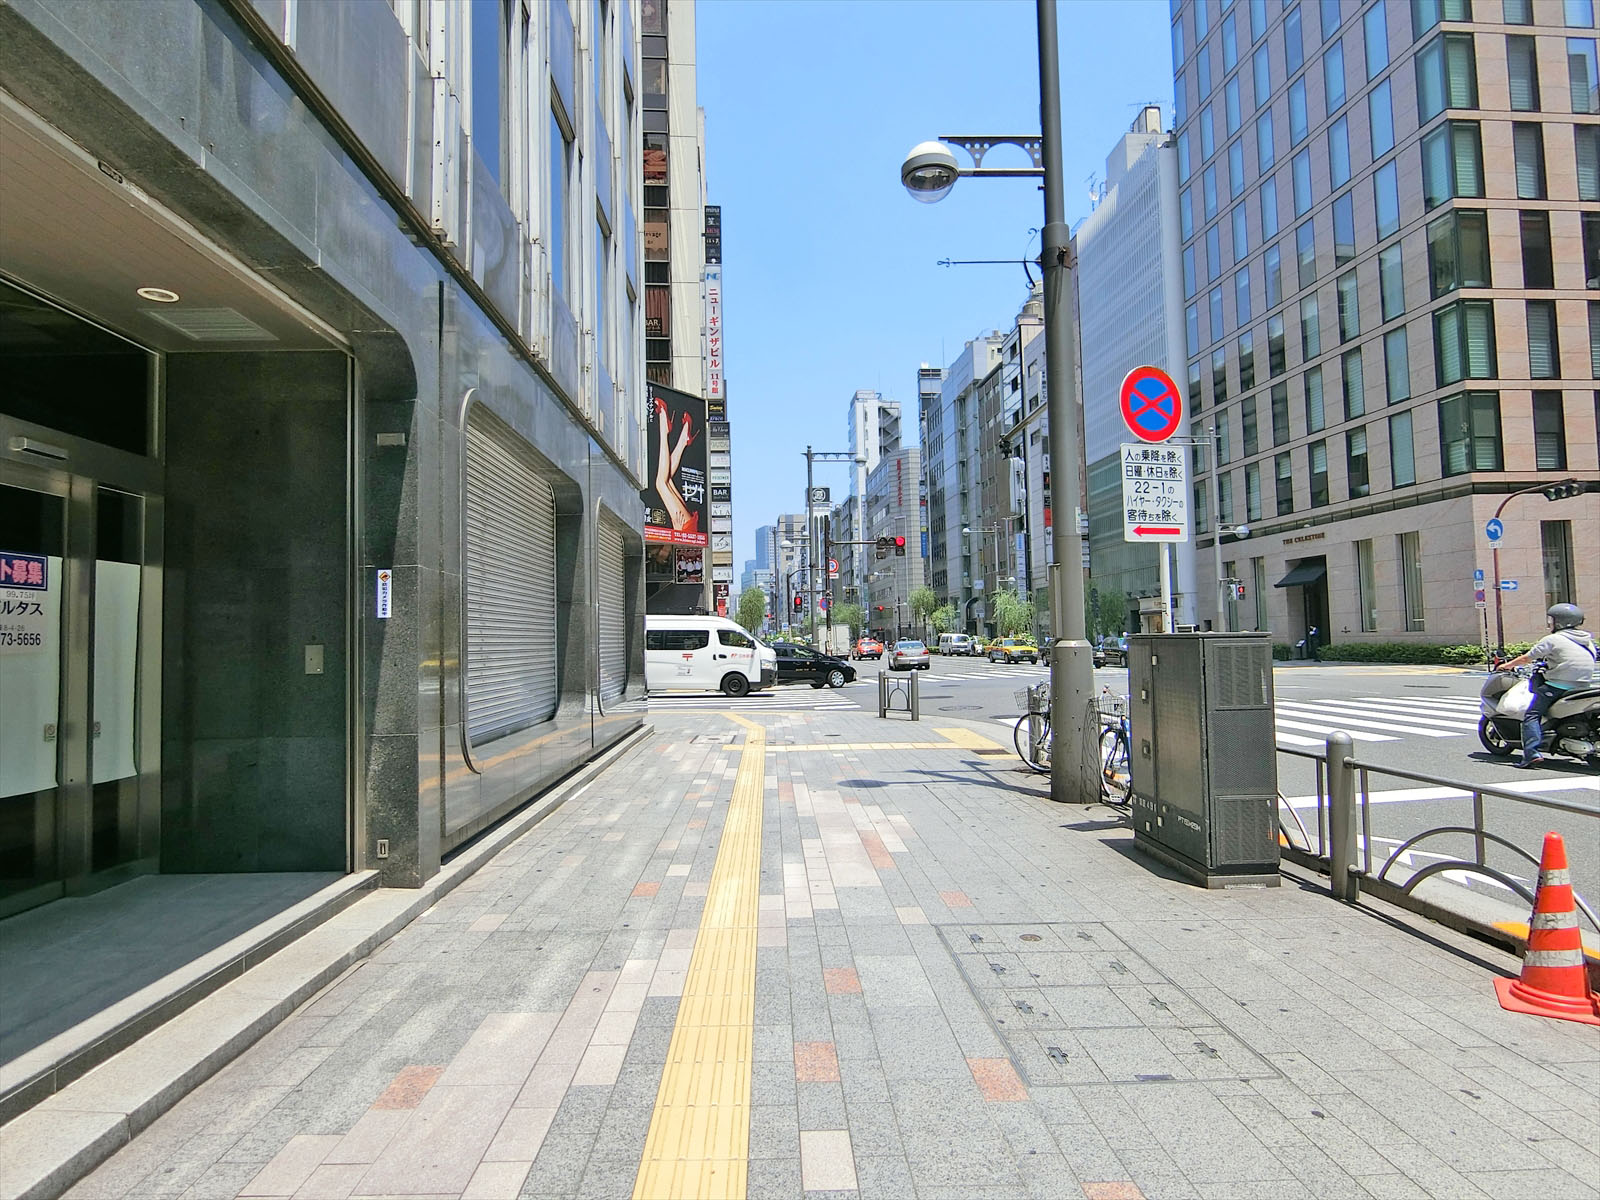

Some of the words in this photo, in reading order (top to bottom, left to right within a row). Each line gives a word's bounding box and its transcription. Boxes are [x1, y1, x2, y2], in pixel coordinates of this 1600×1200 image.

[708, 288, 720, 369] ニューギンザビル
[1125, 449, 1182, 463] 人の乗降を除く
[1126, 465, 1182, 479] 日曜・休日を除く
[1127, 495, 1183, 509] ハイヤー・タクシーの
[1127, 509, 1177, 522] 客待ちを除く
[0, 558, 43, 585] ト募集
[0, 600, 43, 616] ルタス
[0, 632, 42, 646] 73-5656
